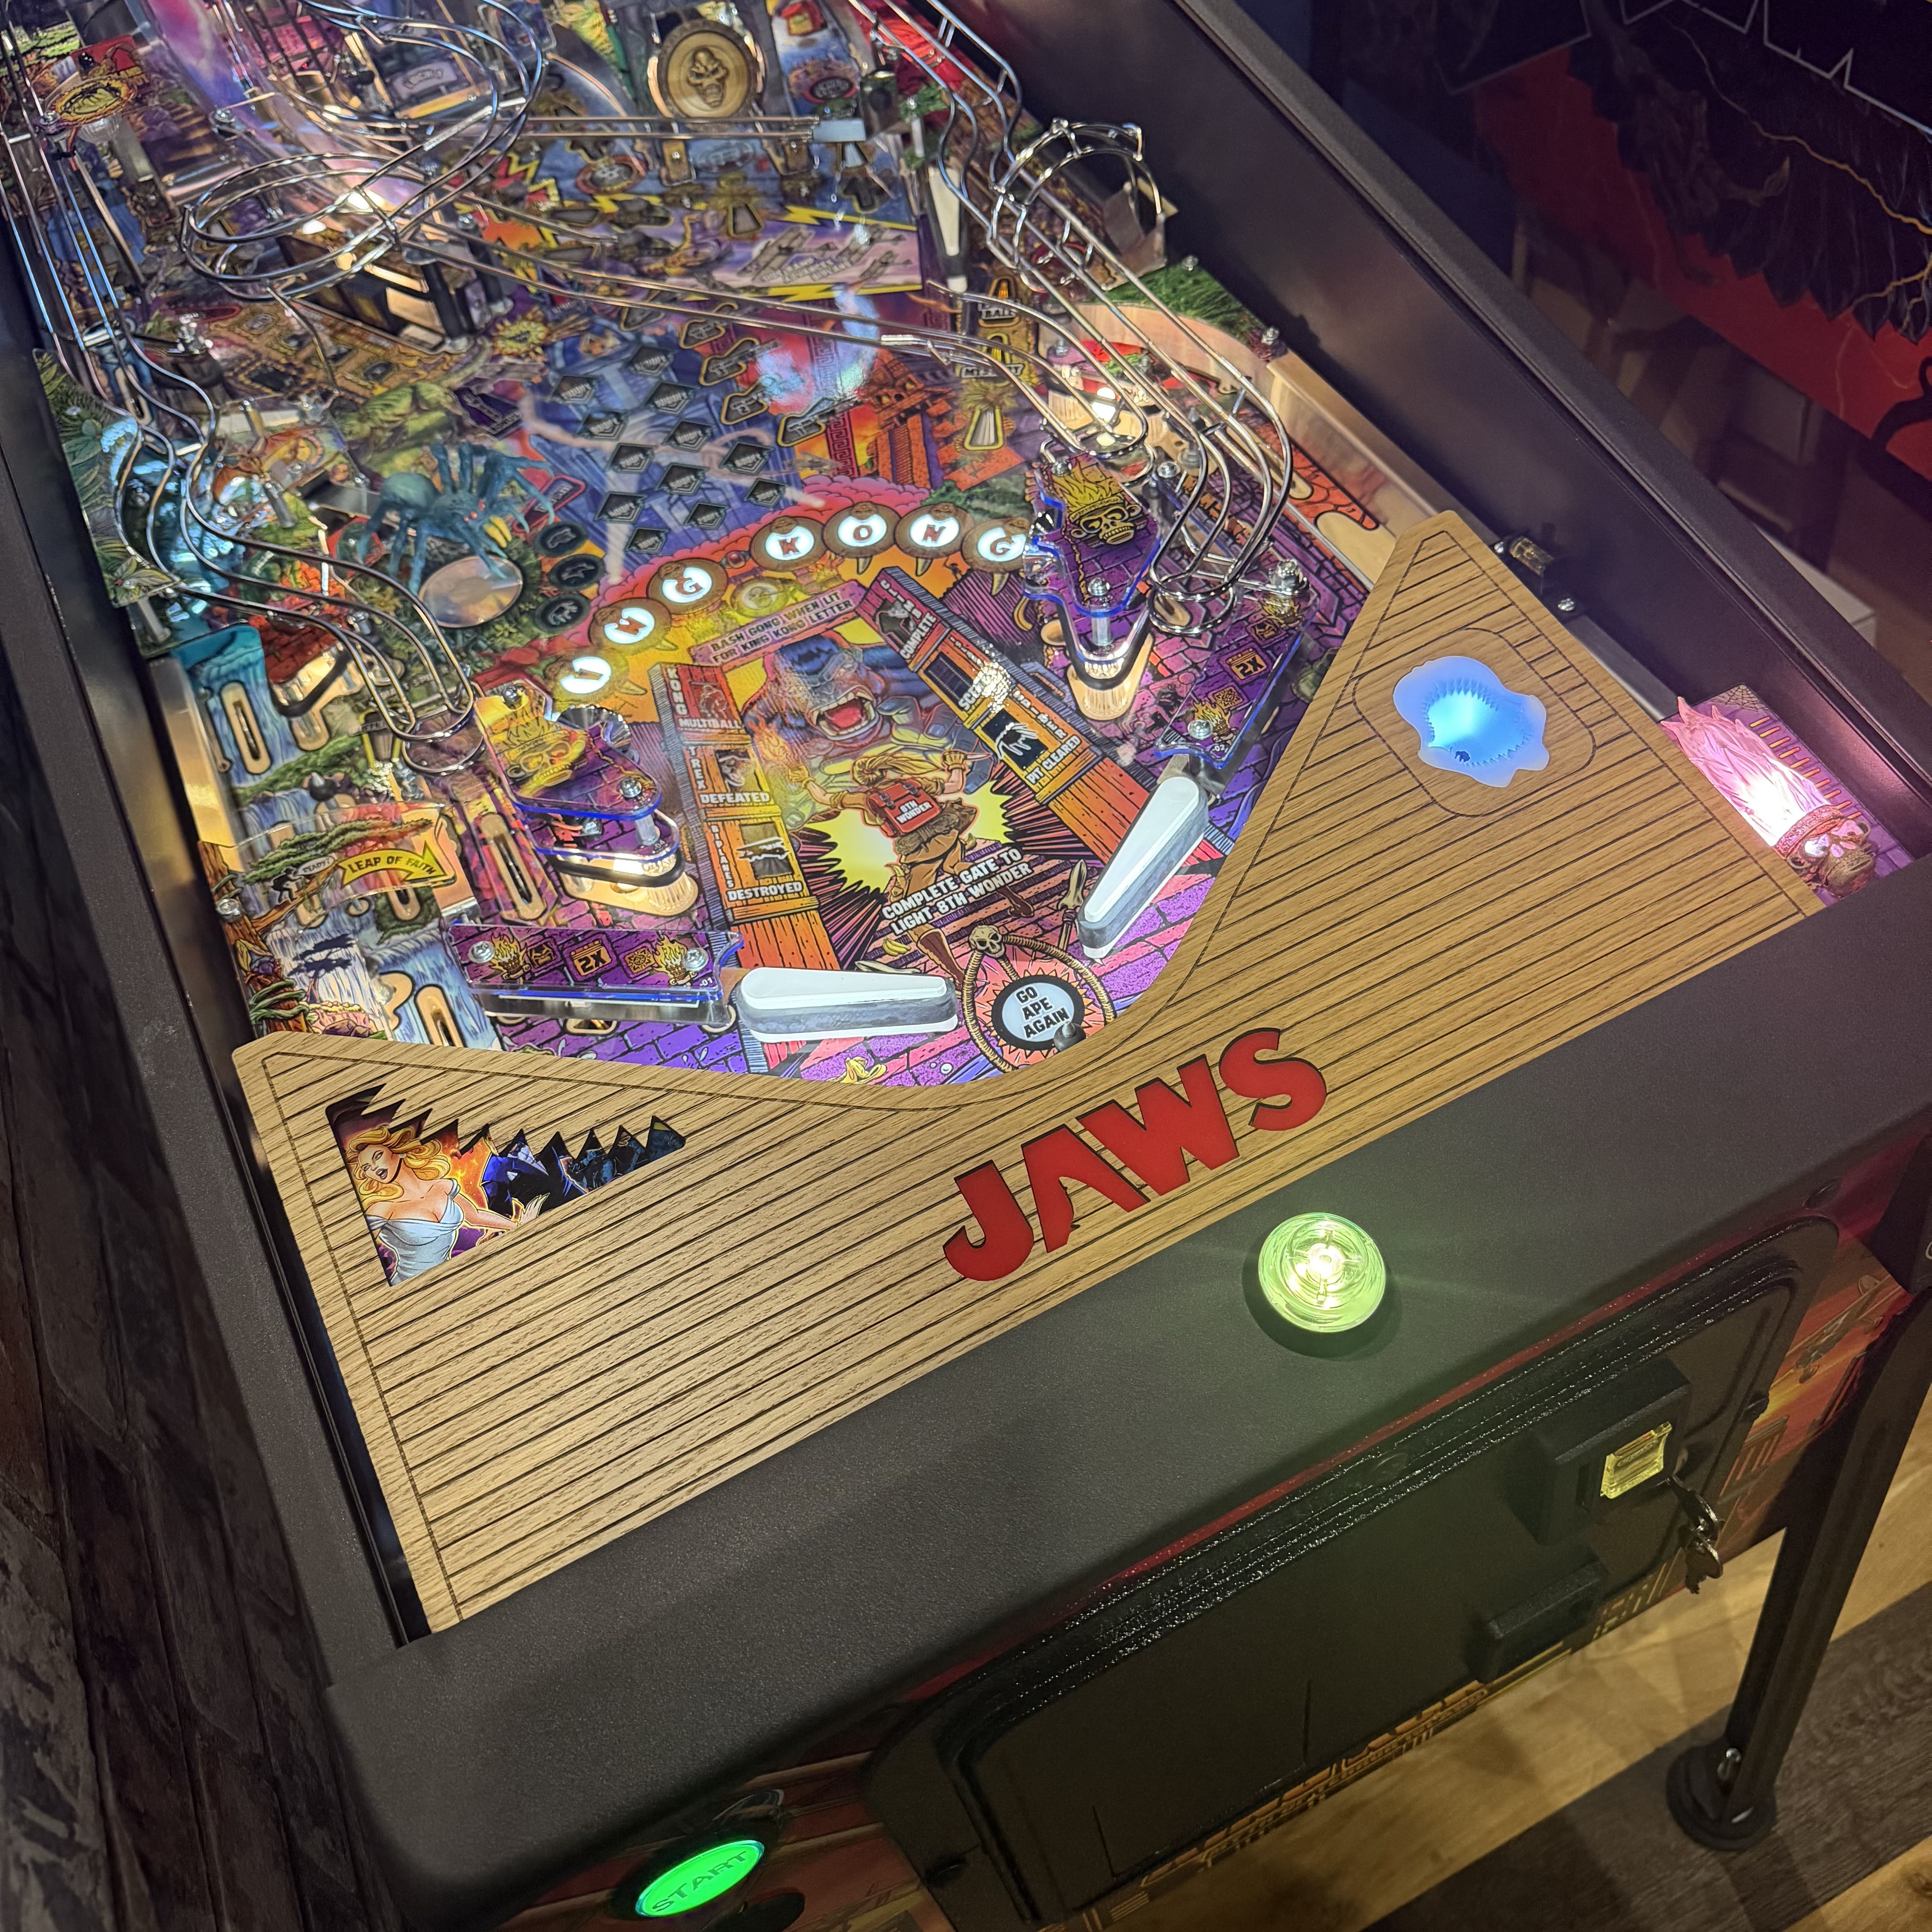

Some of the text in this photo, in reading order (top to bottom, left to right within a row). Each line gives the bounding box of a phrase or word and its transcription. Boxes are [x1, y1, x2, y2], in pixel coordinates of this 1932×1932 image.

[710, 592, 842, 651] BASH GONG WHEN LIT
[713, 600, 854, 663] FOR KING KONG LETTER
[900, 612, 937, 659] COMPLETE
[1236, 656, 1264, 677] 2X
[666, 668, 688, 716] KONG
[679, 718, 741, 729] MULTIBALL
[1026, 735, 1081, 784] PIT CLEARED
[699, 792, 770, 804] DEFEATED
[896, 802, 932, 823] WONDER
[347, 856, 437, 875] LEAP OF FAITH
[711, 825, 734, 888] BIPLANES
[727, 881, 803, 901] DESTROYED
[882, 848, 1022, 919] COMPLETE GATE TO
[890, 862, 1033, 936] LIGHT 8TH WONDER
[578, 949, 606, 973] 2X
[1016, 987, 1038, 1003] GO
[1022, 997, 1053, 1021] APE
[1023, 1007, 1070, 1039] AGAIN
[943, 1027, 1327, 1282] JAWS
[652, 1850, 747, 1912] START
